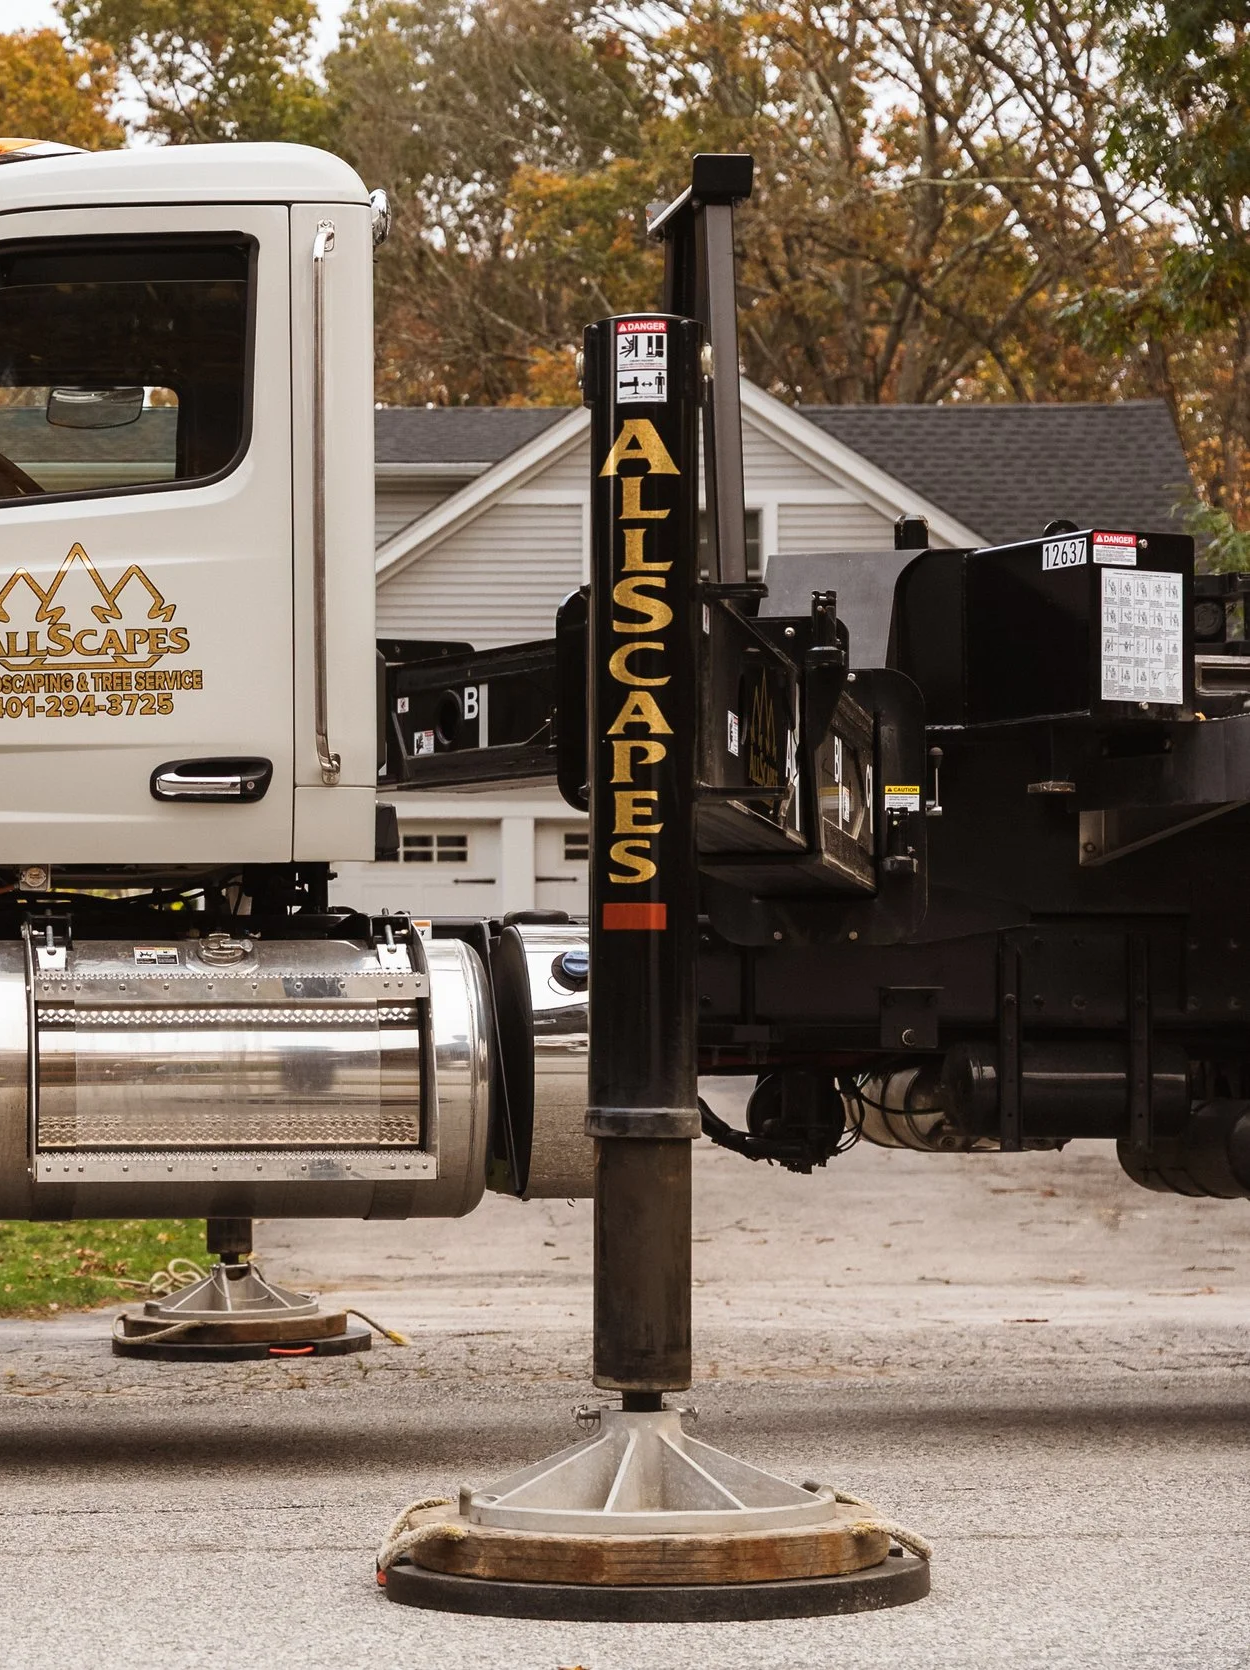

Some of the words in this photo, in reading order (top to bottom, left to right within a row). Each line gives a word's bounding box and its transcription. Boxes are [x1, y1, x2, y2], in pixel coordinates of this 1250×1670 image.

[627, 322, 665, 331] DANGER
[1103, 535, 1134, 545] DANGER
[1044, 541, 1085, 568] 12637
[598, 418, 681, 884] ALLSCAPES
[77, 673, 89, 693] &
[91, 671, 132, 692] TREE
[135, 670, 203, 690] SERVICE
[464, 687, 478, 720] B
